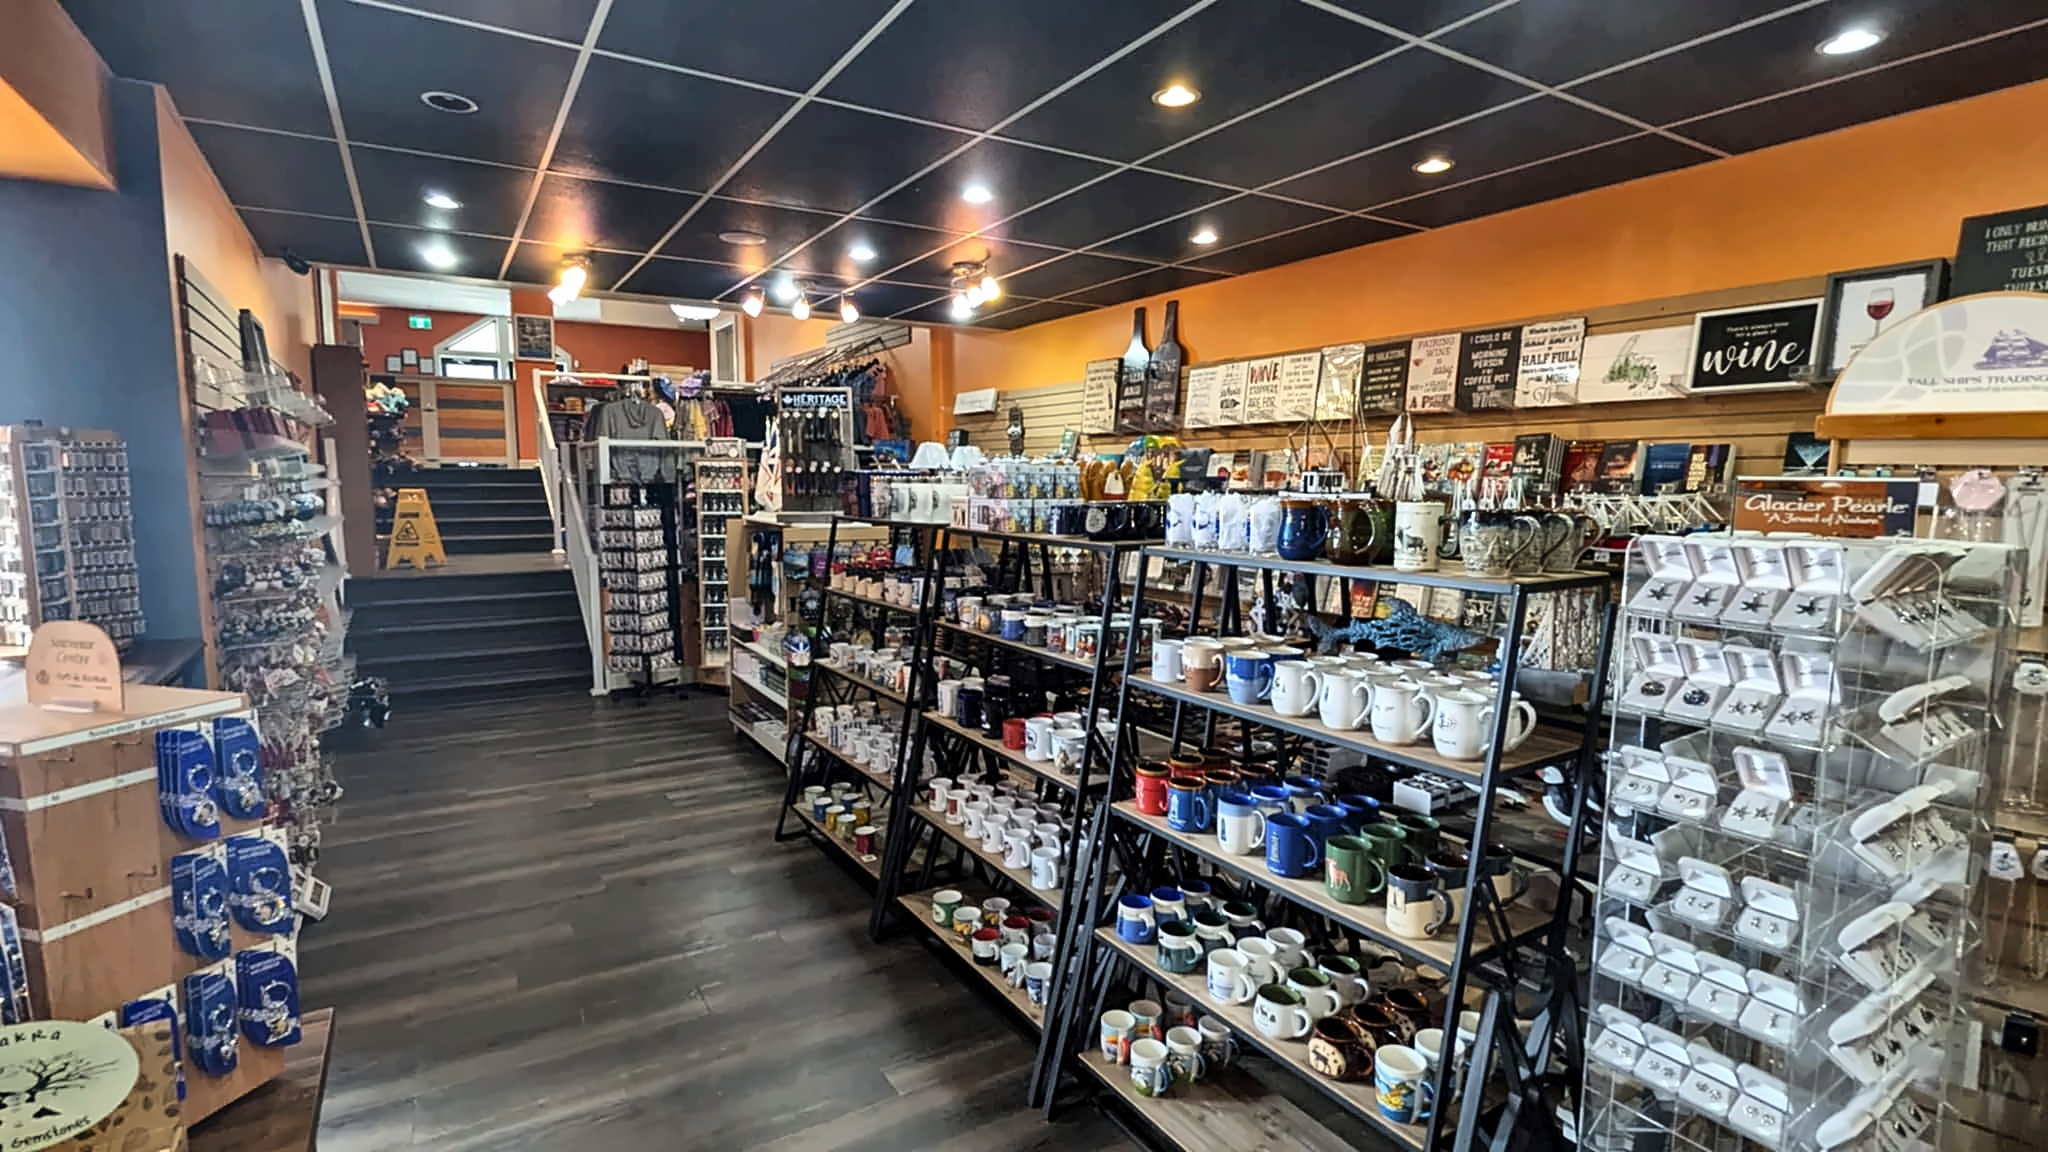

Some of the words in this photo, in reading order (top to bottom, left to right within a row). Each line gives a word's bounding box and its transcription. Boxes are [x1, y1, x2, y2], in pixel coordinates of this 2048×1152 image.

[1992, 223, 2021, 239] ONLY
[1986, 238, 2016, 254] THAT
[1475, 332, 1500, 344] COULD
[1502, 331, 1512, 341] BE
[1471, 348, 1508, 360] MORNING
[1522, 353, 1550, 367] HALF
[1551, 350, 1577, 364] FULL
[1702, 339, 1805, 375] wine
[1473, 358, 1504, 368] PERSON
[1250, 361, 1280, 385] WINE
[1464, 375, 1492, 386] COFFEE
[1494, 373, 1510, 384] POT
[1907, 377, 1938, 386] TALL
[1944, 376, 1982, 386] SHIPS
[1744, 494, 1825, 512] Glacier
[1821, 513, 1834, 526] of
[11, 1115, 90, 1149] Gemstones
